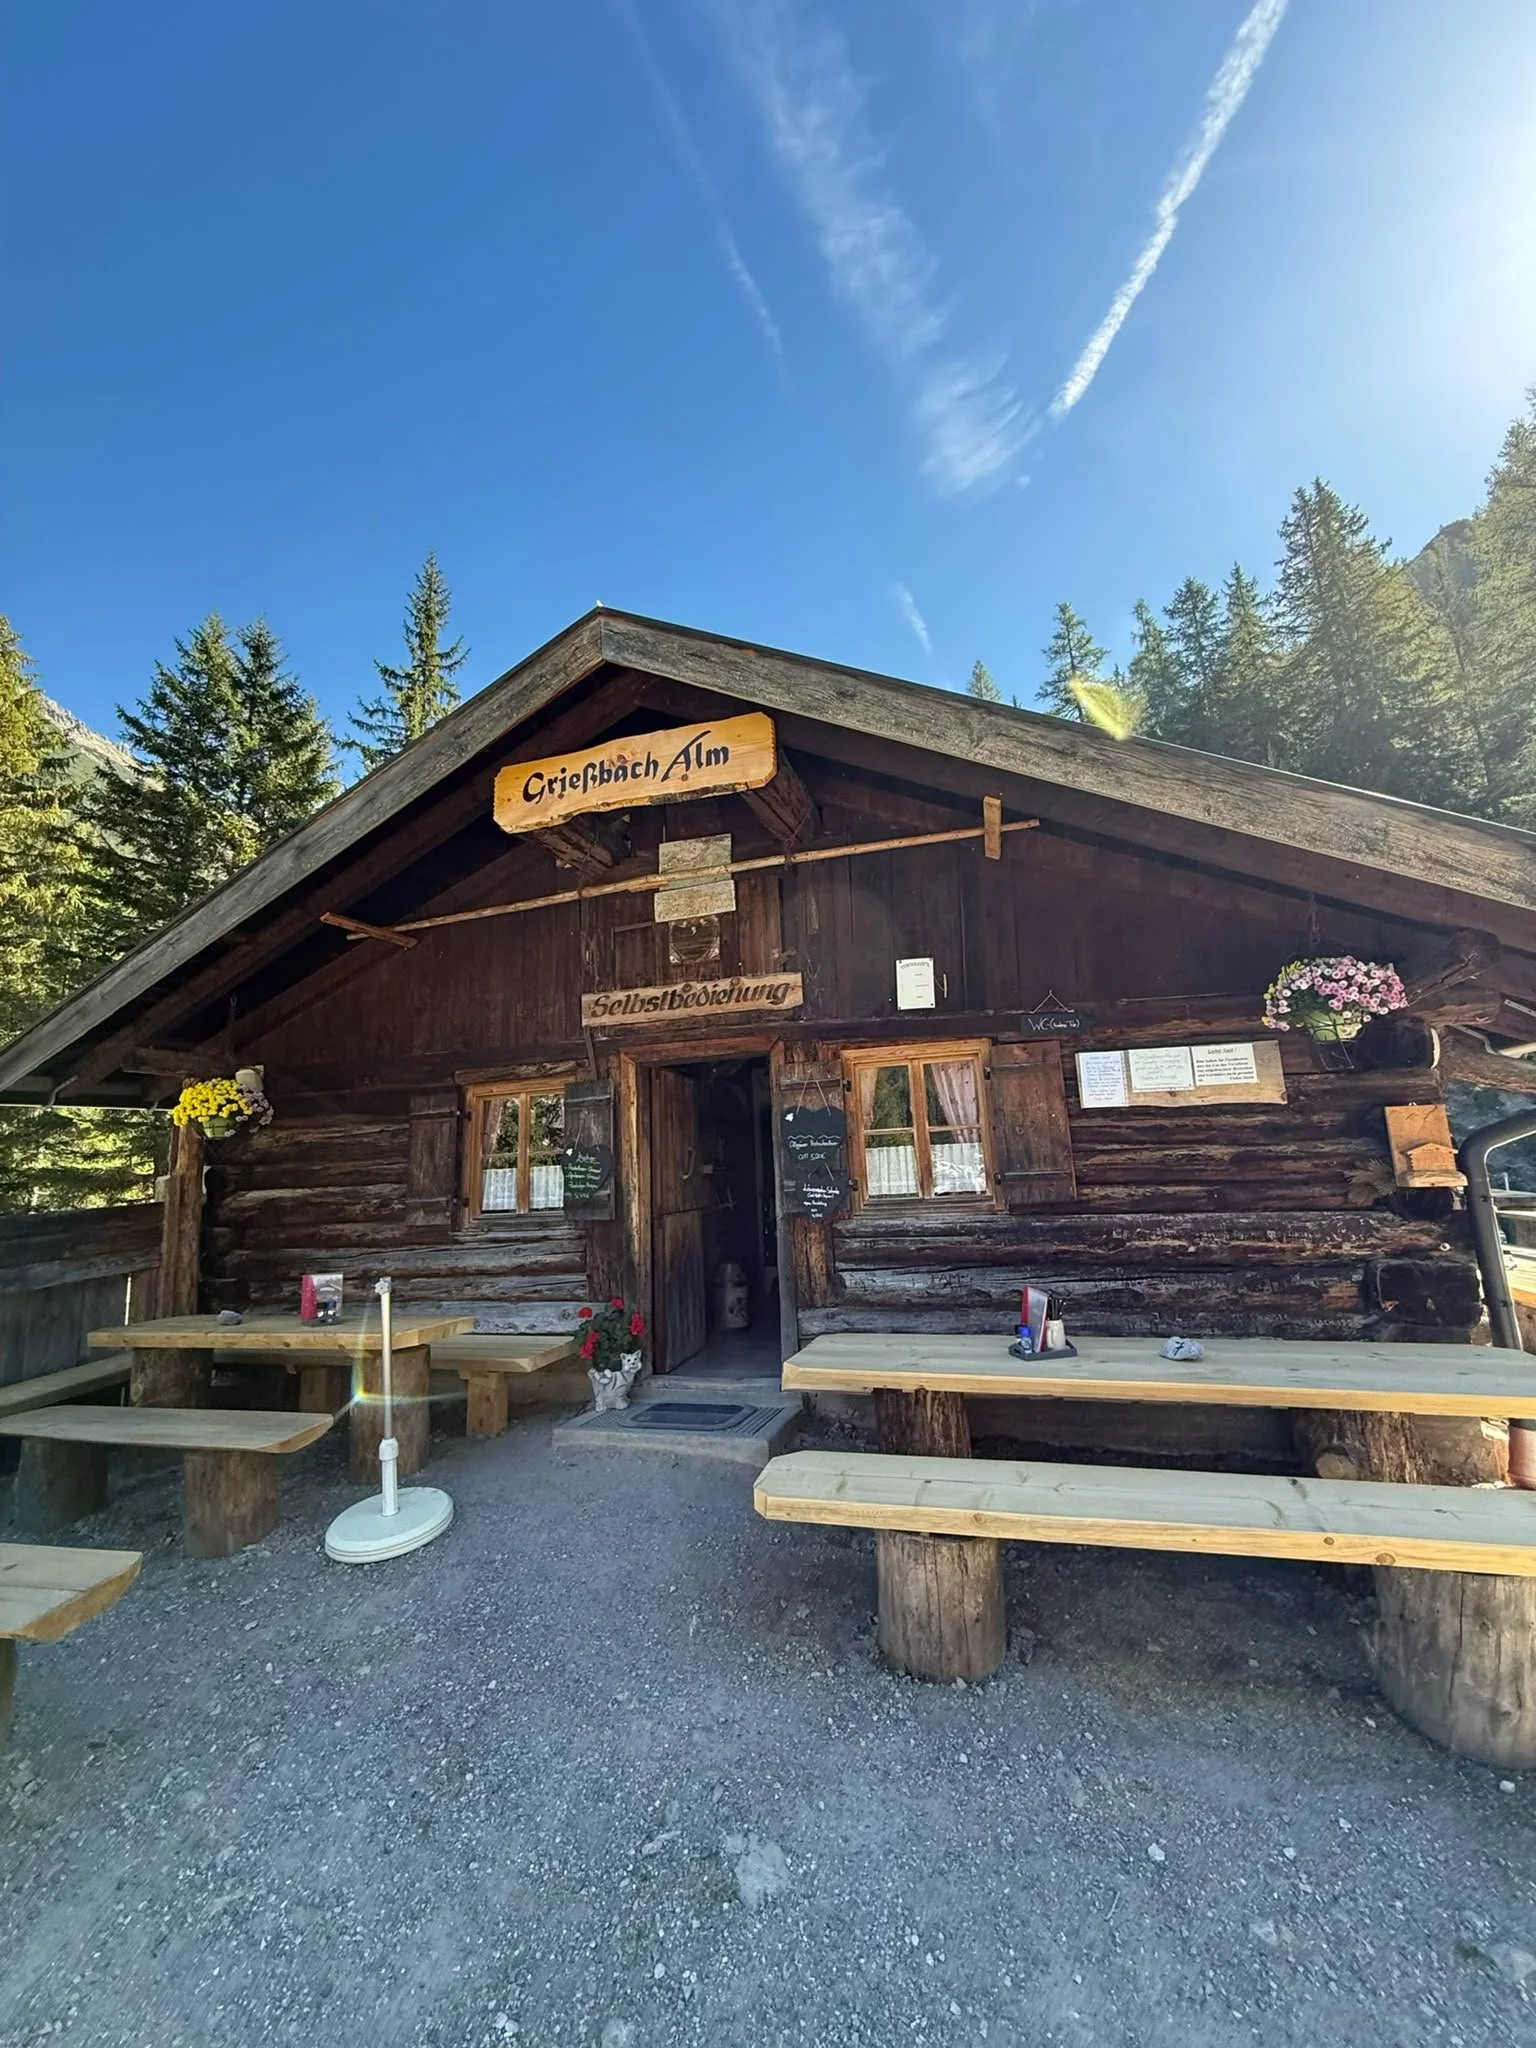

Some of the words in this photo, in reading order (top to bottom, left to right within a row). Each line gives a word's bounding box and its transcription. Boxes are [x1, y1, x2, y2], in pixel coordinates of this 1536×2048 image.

[522, 751, 659, 804] Grießbach
[661, 730, 729, 782] Alm
[591, 982, 791, 1018] Selbstbedienung
[1174, 1341, 1184, 1356] 7
